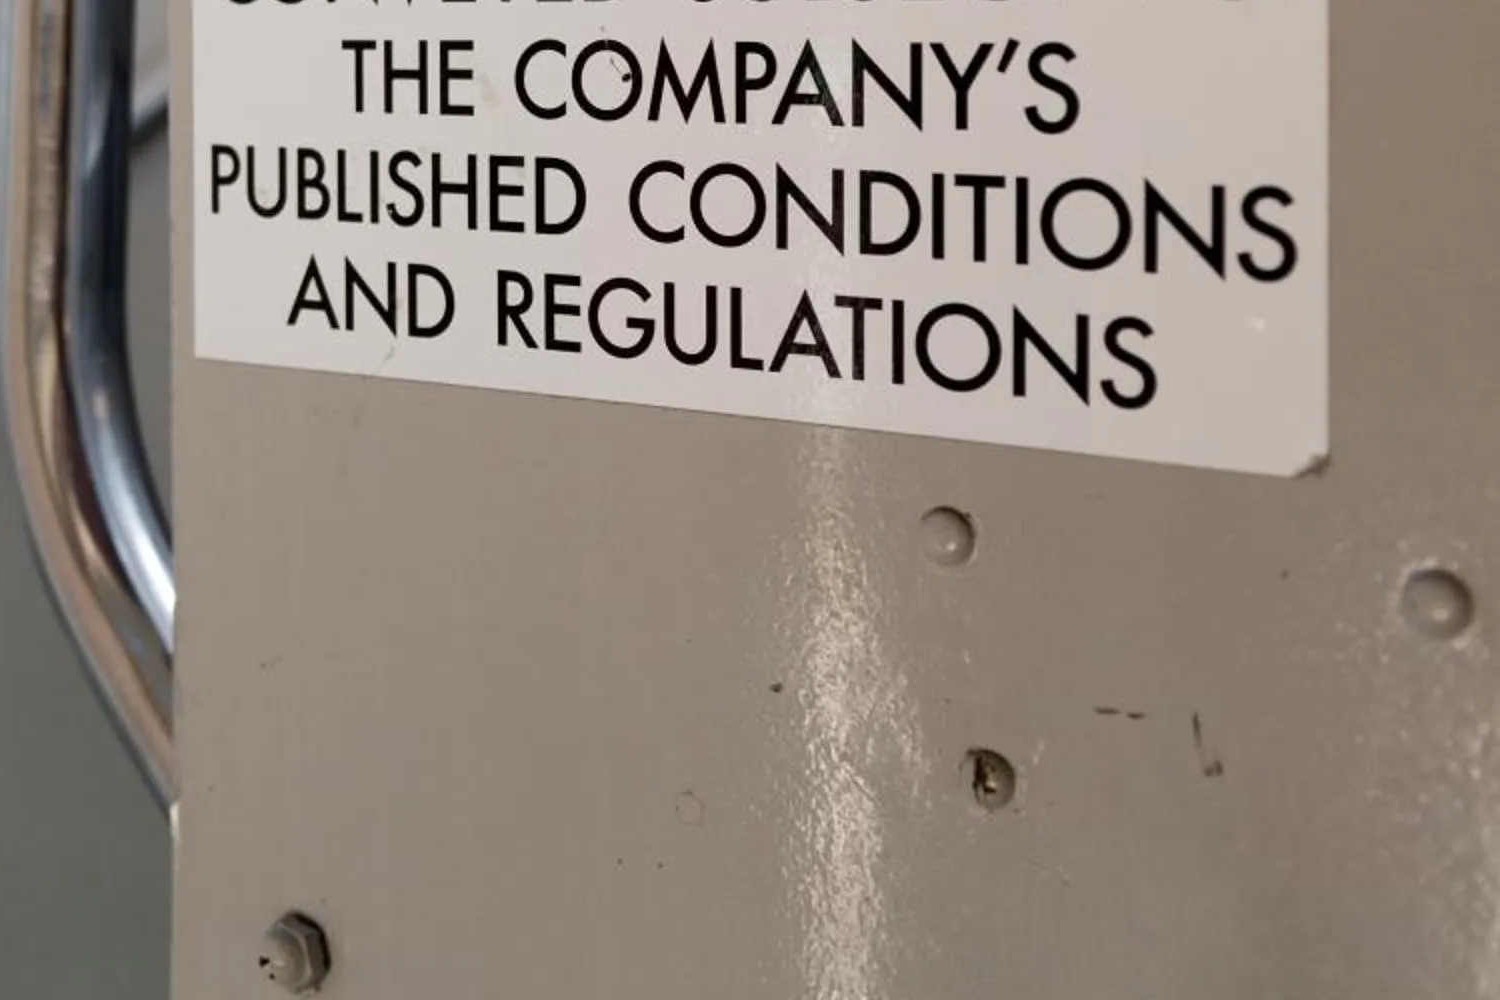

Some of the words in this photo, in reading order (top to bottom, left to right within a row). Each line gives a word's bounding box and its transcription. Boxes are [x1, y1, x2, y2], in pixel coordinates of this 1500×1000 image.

[340, 38, 476, 118] THE
[513, 36, 1081, 136] COMPANY'S
[210, 143, 588, 236] PUBLISHED
[627, 158, 1299, 284] CONDITIONS
[286, 254, 456, 340] AND
[496, 268, 1159, 411] REGULATIONS
